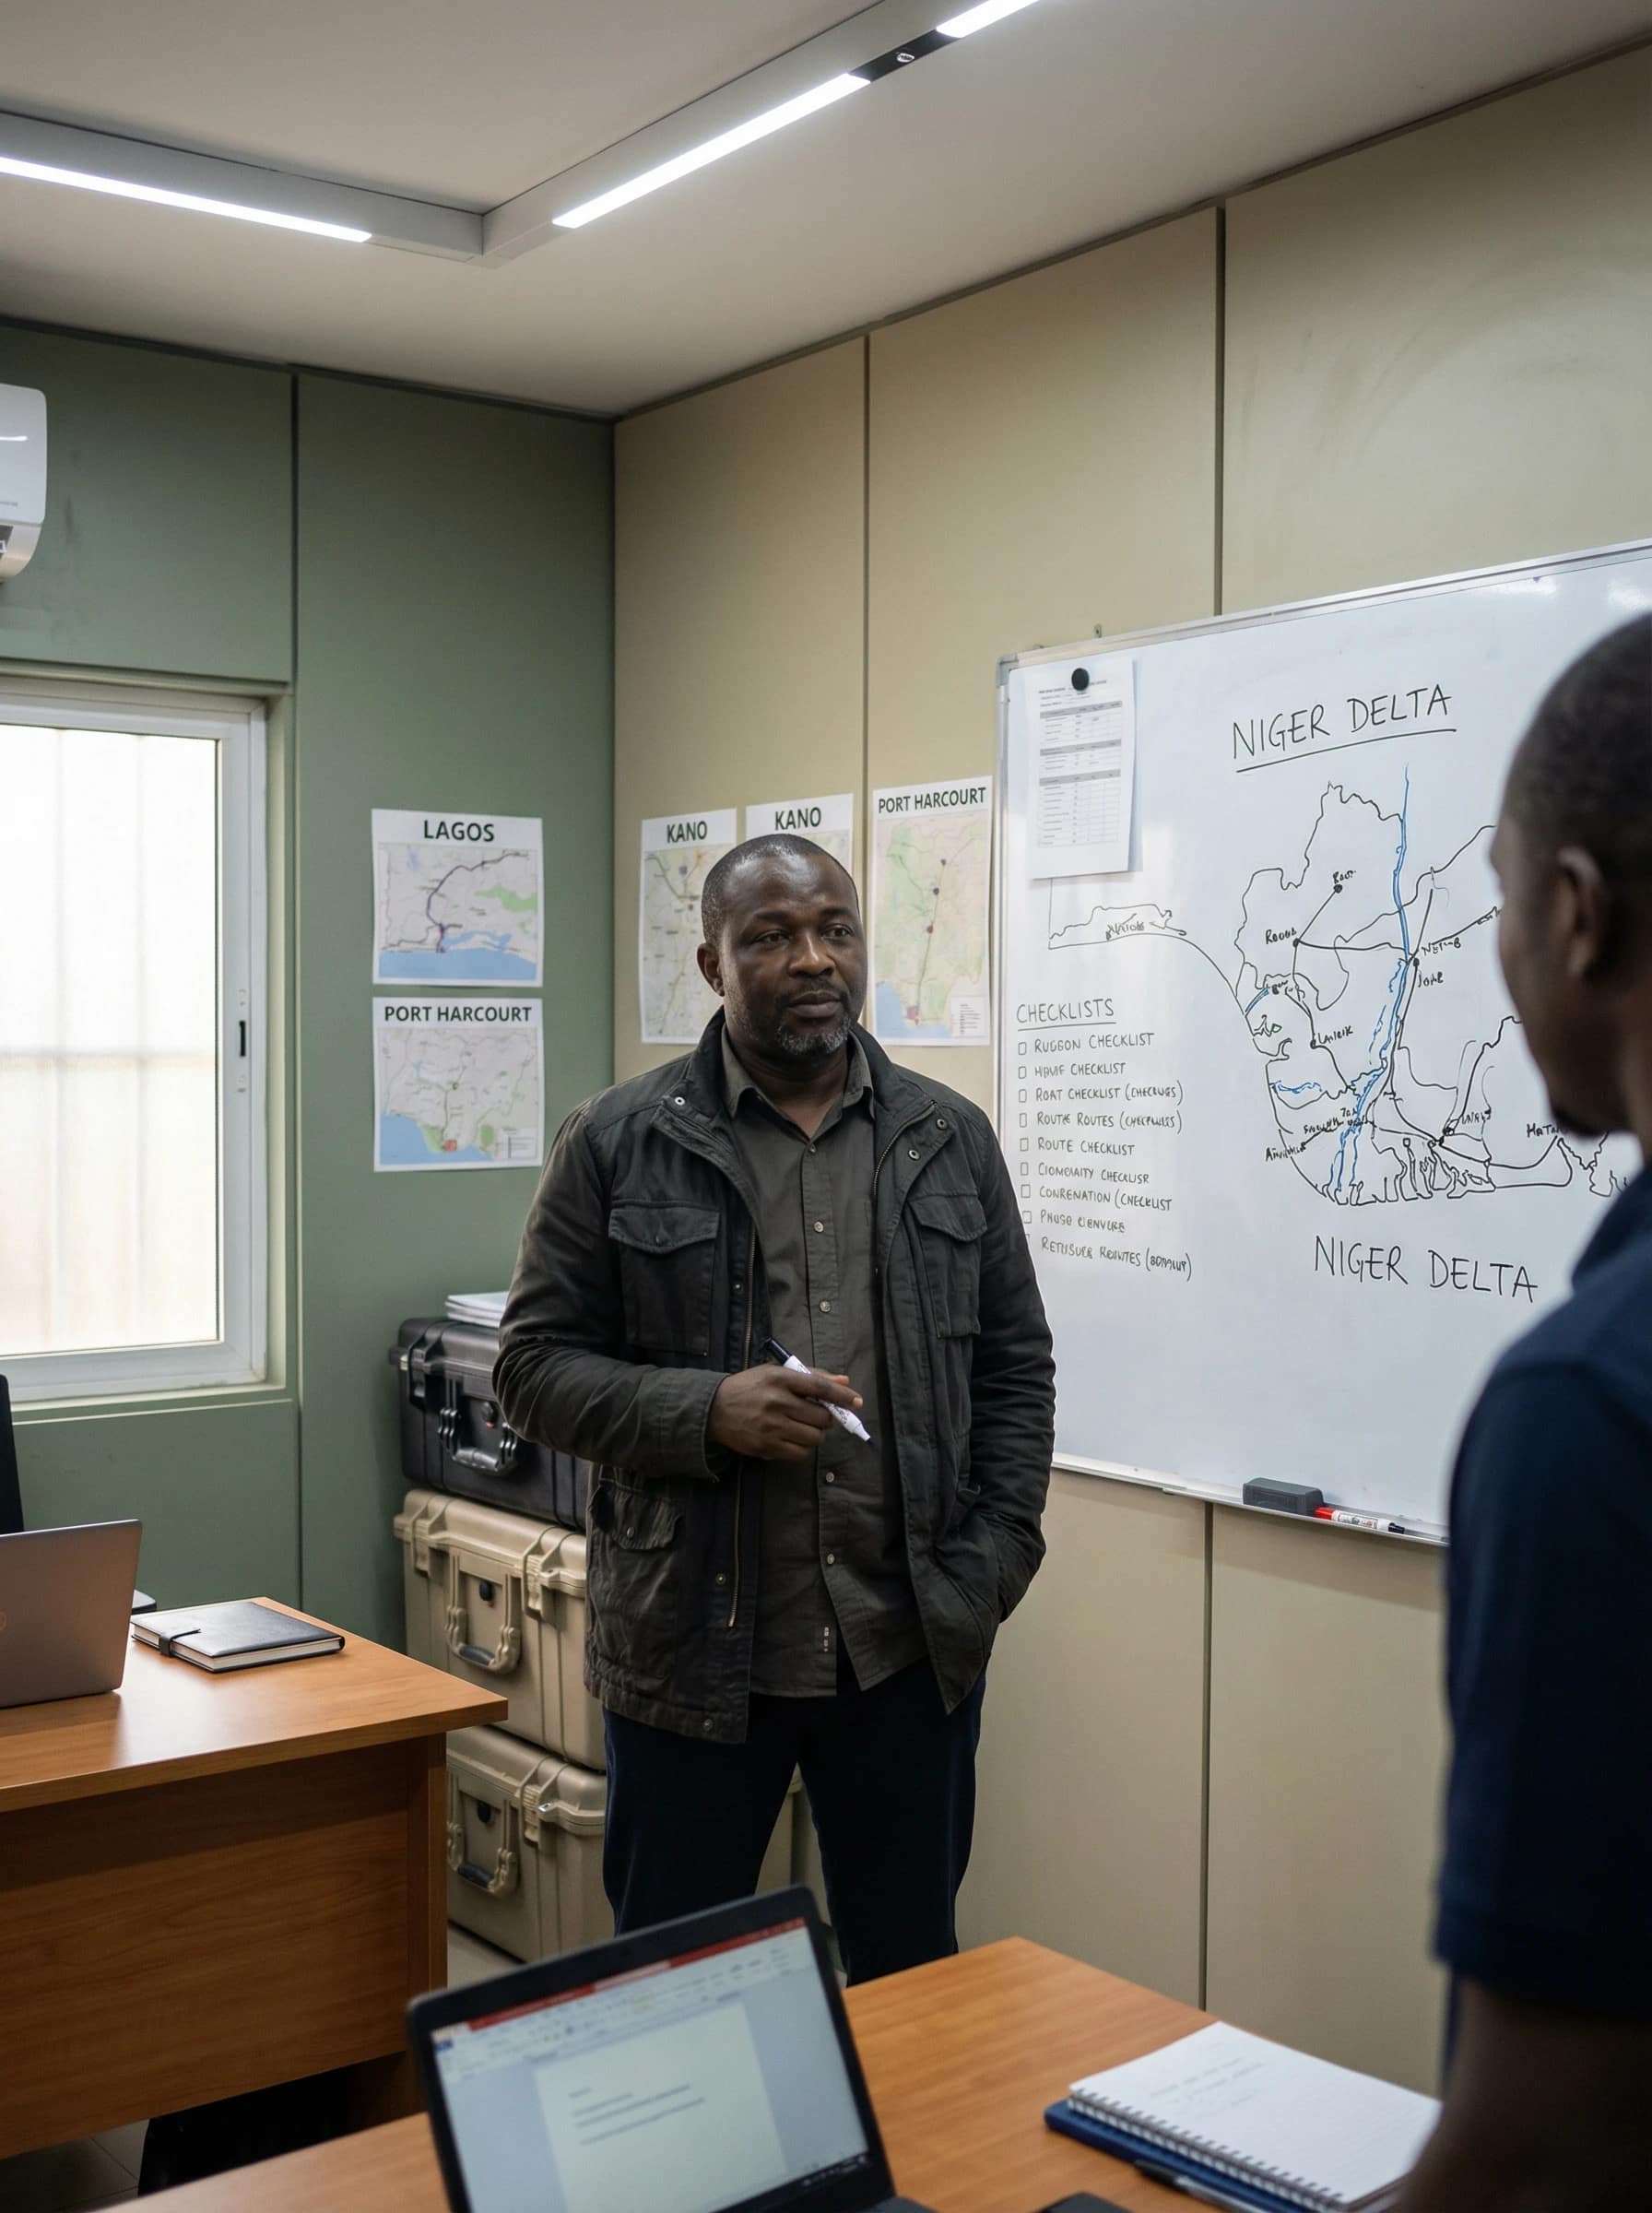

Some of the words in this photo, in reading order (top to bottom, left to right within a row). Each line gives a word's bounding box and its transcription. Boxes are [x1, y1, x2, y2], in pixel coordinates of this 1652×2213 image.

[1233, 704, 1330, 760] NIGER
[1346, 684, 1452, 733] DELTA
[878, 795, 911, 814] PORT
[914, 787, 987, 810] HARCOURT
[774, 806, 822, 831] KANO
[423, 819, 495, 843] LAGOS
[667, 820, 708, 844] KANO
[384, 1005, 432, 1023] PORT
[437, 1005, 532, 1023] HARCOURT
[1016, 998, 1115, 1024] CHECKLISTS
[1088, 1032, 1155, 1049] CHECKLIST
[1070, 1062, 1127, 1076] CHECKLIST
[1068, 1087, 1121, 1100] CHECKLIST
[1077, 1112, 1115, 1128] ROUTES
[1038, 1136, 1073, 1153] ROUTE
[1080, 1140, 1136, 1156] CHECKLIST
[1315, 1235, 1409, 1284] NIGER
[1428, 1249, 1539, 1304] DELTA
